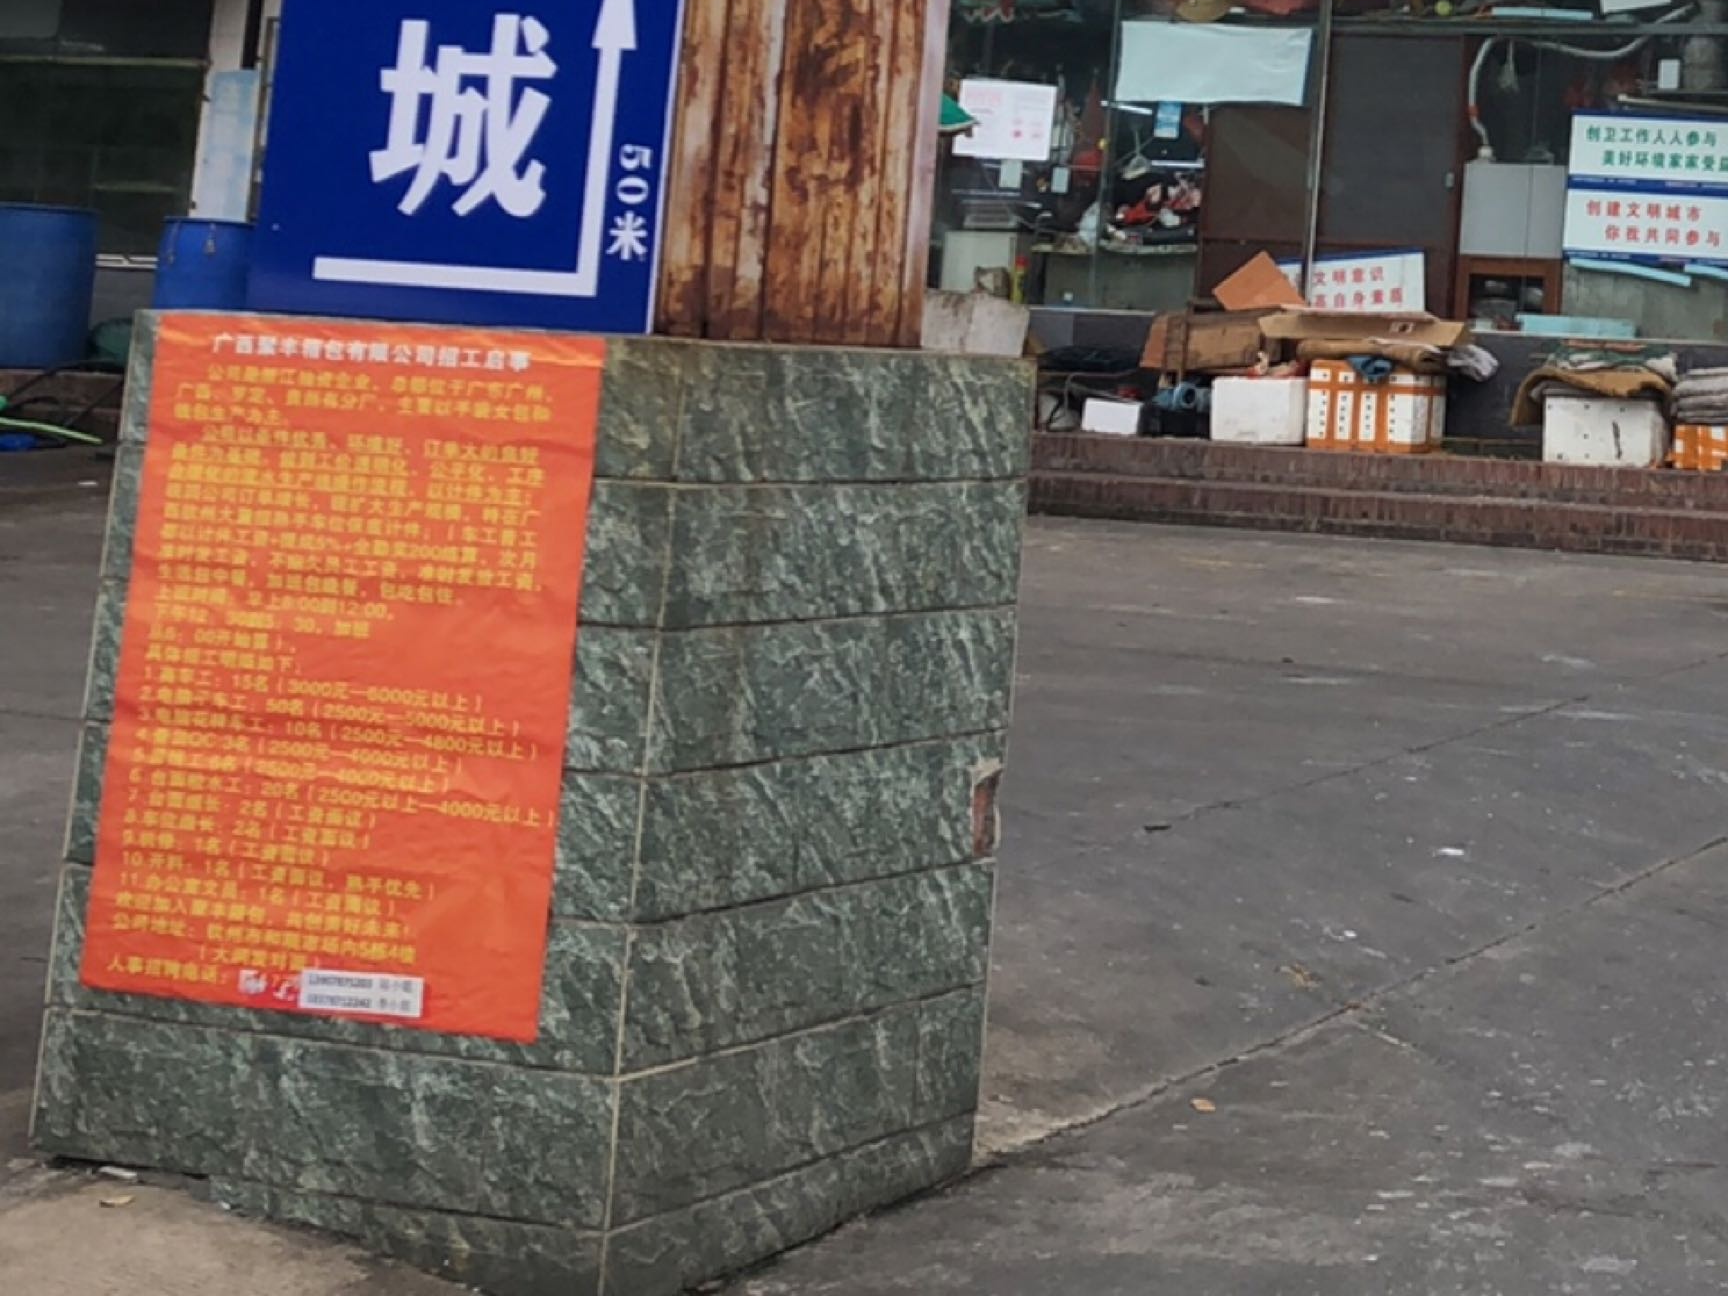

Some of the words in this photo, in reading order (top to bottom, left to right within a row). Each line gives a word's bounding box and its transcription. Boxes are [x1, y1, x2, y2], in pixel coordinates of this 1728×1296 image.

[1585, 124, 1718, 147] 创卫工作人人参与
[606, 143, 653, 261] 50米
[1585, 199, 1702, 223] 创建文明城市
[1604, 224, 1722, 248] 你我共同参与
